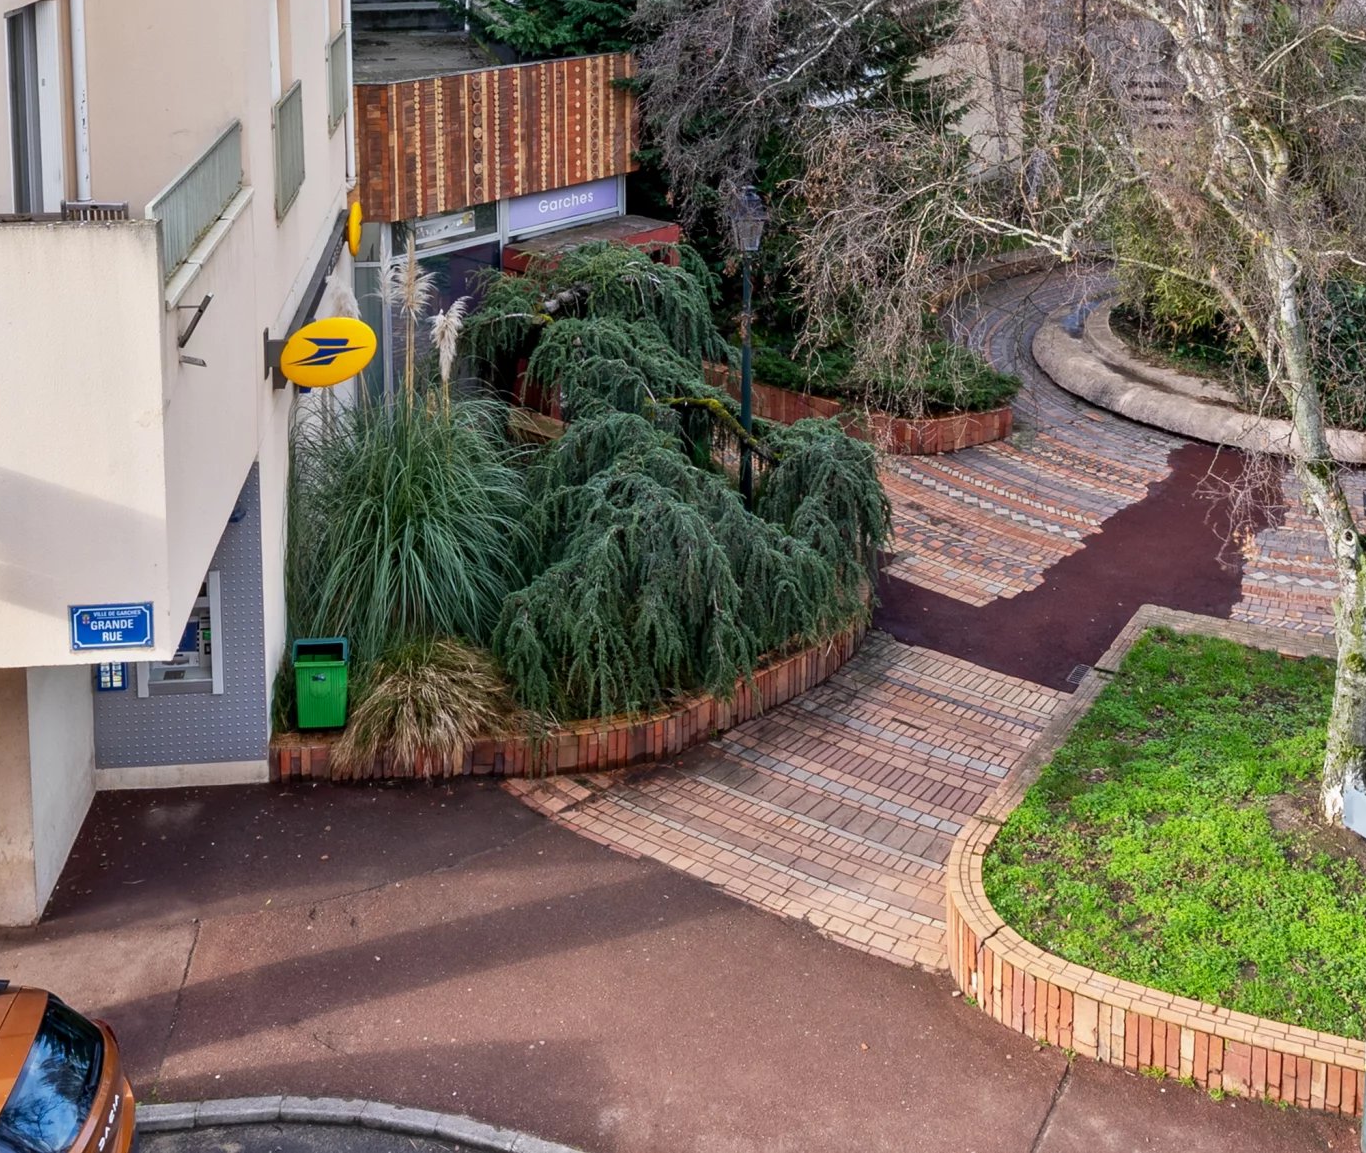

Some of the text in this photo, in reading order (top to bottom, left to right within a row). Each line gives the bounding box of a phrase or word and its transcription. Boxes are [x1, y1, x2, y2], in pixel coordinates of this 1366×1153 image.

[538, 192, 594, 213] Garches
[90, 618, 134, 631] GRANDE
[102, 631, 123, 641] RUE
